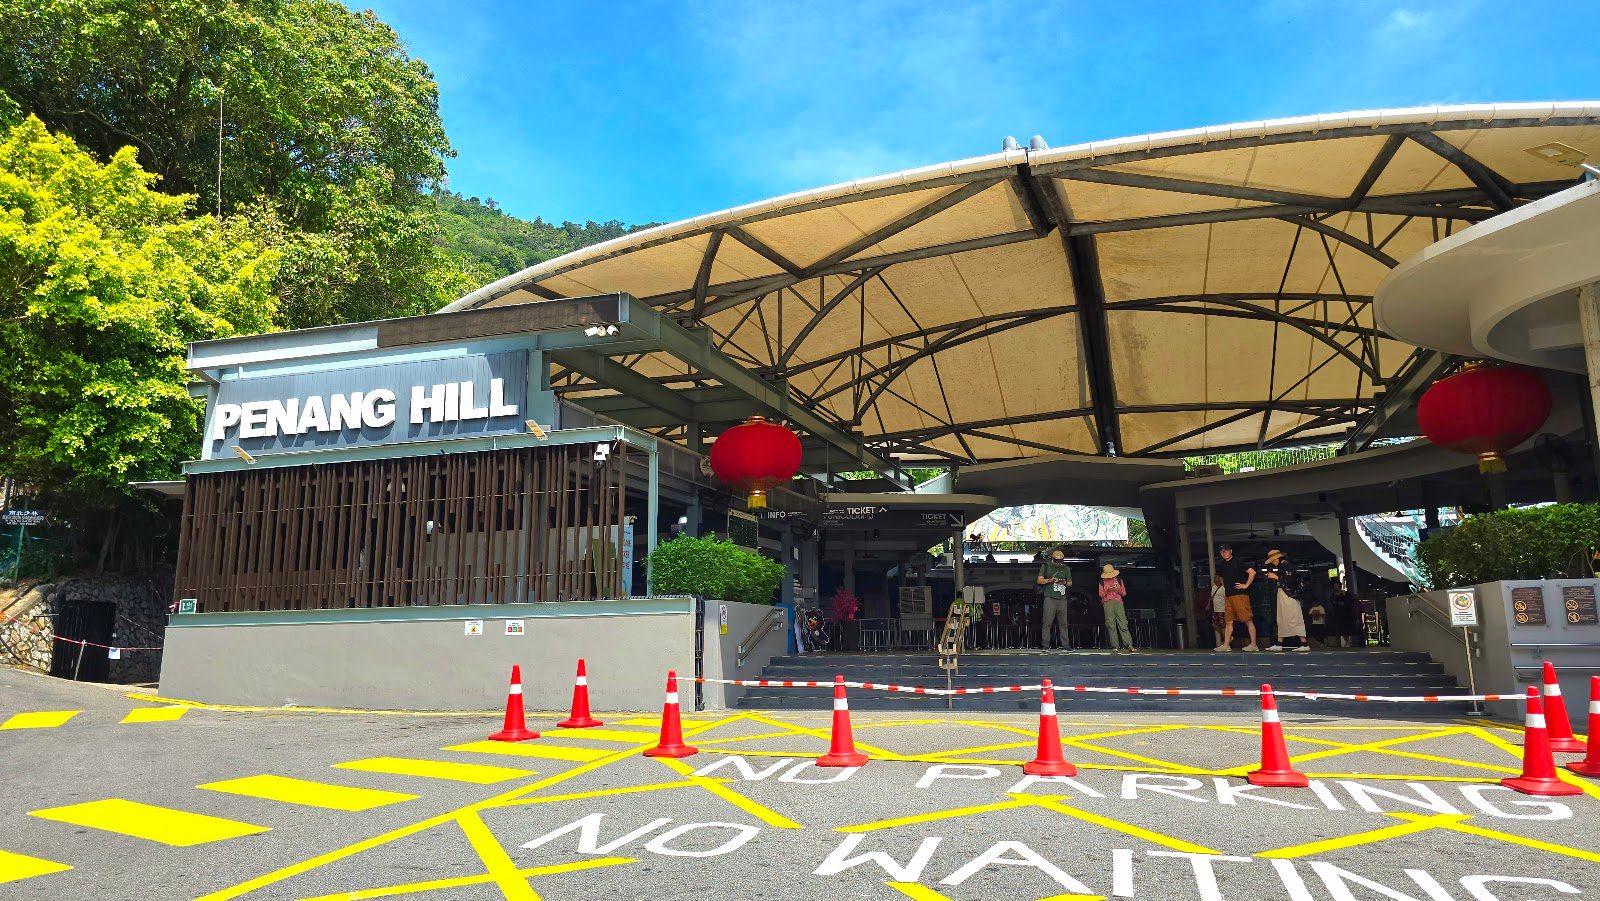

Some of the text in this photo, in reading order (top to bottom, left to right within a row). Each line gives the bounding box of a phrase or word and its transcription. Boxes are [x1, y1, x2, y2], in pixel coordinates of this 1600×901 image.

[212, 377, 519, 441] PENANG HILL
[847, 506, 875, 514] TICKET
[690, 755, 1574, 821] NO PARKING
[518, 812, 760, 858] NO
